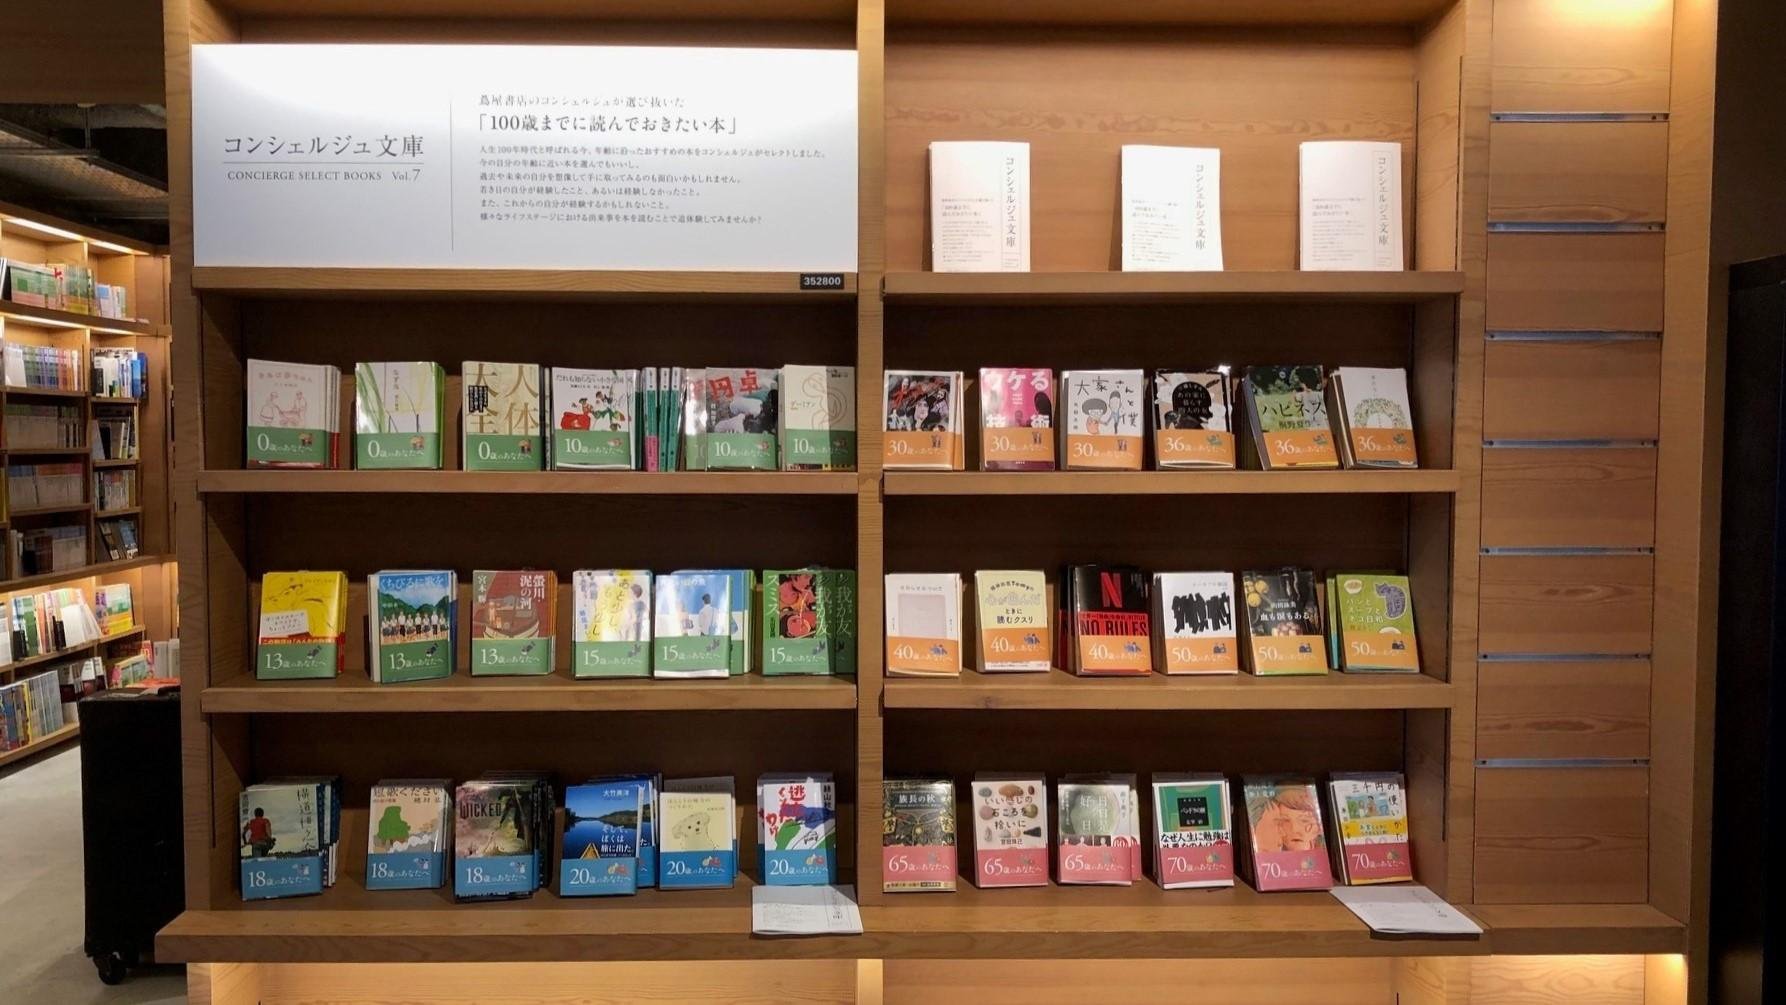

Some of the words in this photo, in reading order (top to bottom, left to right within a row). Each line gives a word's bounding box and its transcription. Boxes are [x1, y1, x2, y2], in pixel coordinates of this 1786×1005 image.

[479, 113, 736, 134] 「100歳までに読んでおきたい本」
[224, 134, 424, 158] コンシェルジュ文庫
[227, 171, 295, 181] CONCIERGE
[298, 171, 340, 181] SELECT
[343, 171, 382, 181] BOOKS
[392, 168, 421, 182] Vol.7
[1005, 157, 1017, 248] コンシェルジュ文庫
[804, 276, 841, 286] 352800
[708, 369, 760, 400] 円卓
[520, 574, 532, 610] 泥の河
[767, 574, 780, 615] スミス
[1101, 571, 1123, 609] N
[996, 615, 1034, 625] 読むクスリ
[1080, 619, 1100, 636] NO
[1104, 620, 1149, 637] RULES
[899, 794, 936, 804] 族長の秋
[459, 801, 501, 820] WICKED
[1160, 831, 1229, 842] なぜ人生に勉強は
[666, 860, 726, 876] 20歳のあなたへ
